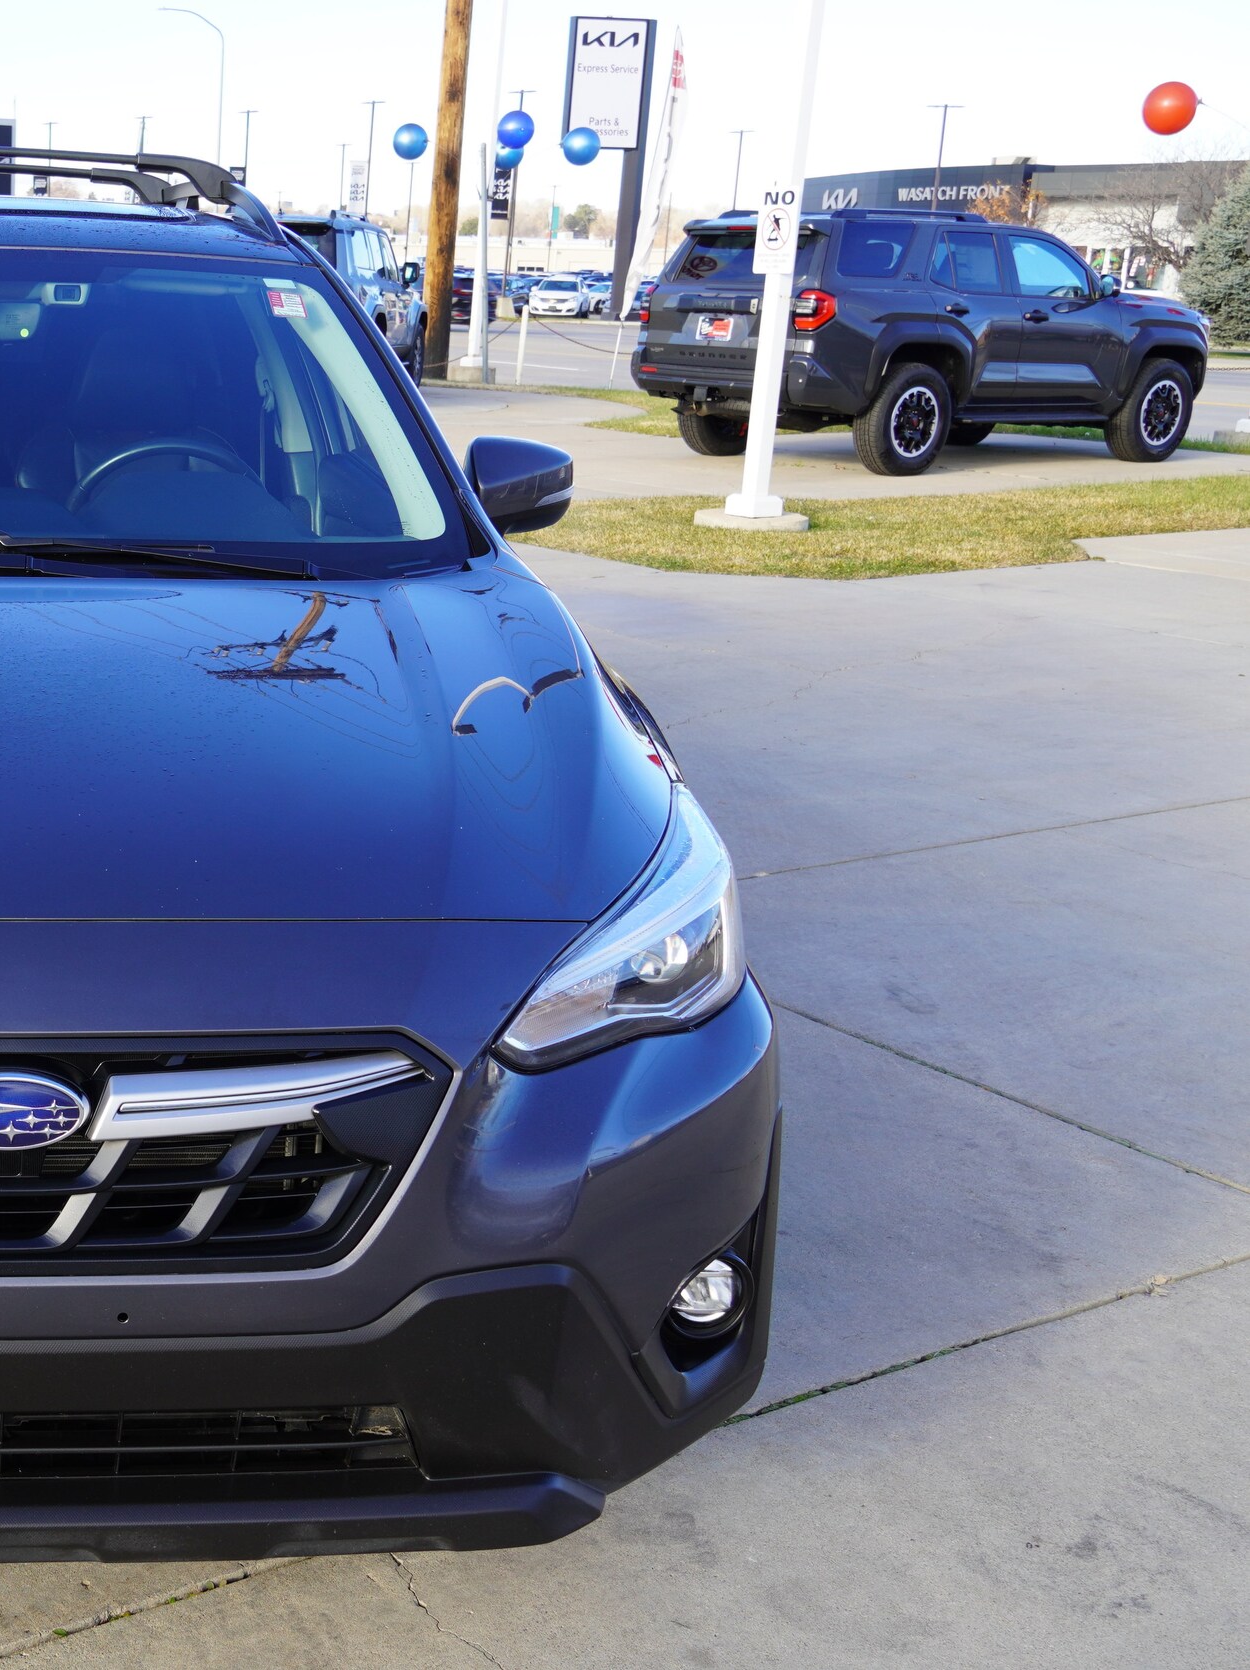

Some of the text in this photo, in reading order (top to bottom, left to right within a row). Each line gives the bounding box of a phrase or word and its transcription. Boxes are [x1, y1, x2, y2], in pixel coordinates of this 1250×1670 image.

[582, 31, 639, 48] KIA
[577, 63, 639, 74] Express Service
[589, 117, 620, 126] Parts &
[764, 190, 795, 205] NO
[822, 187, 858, 210] KIA
